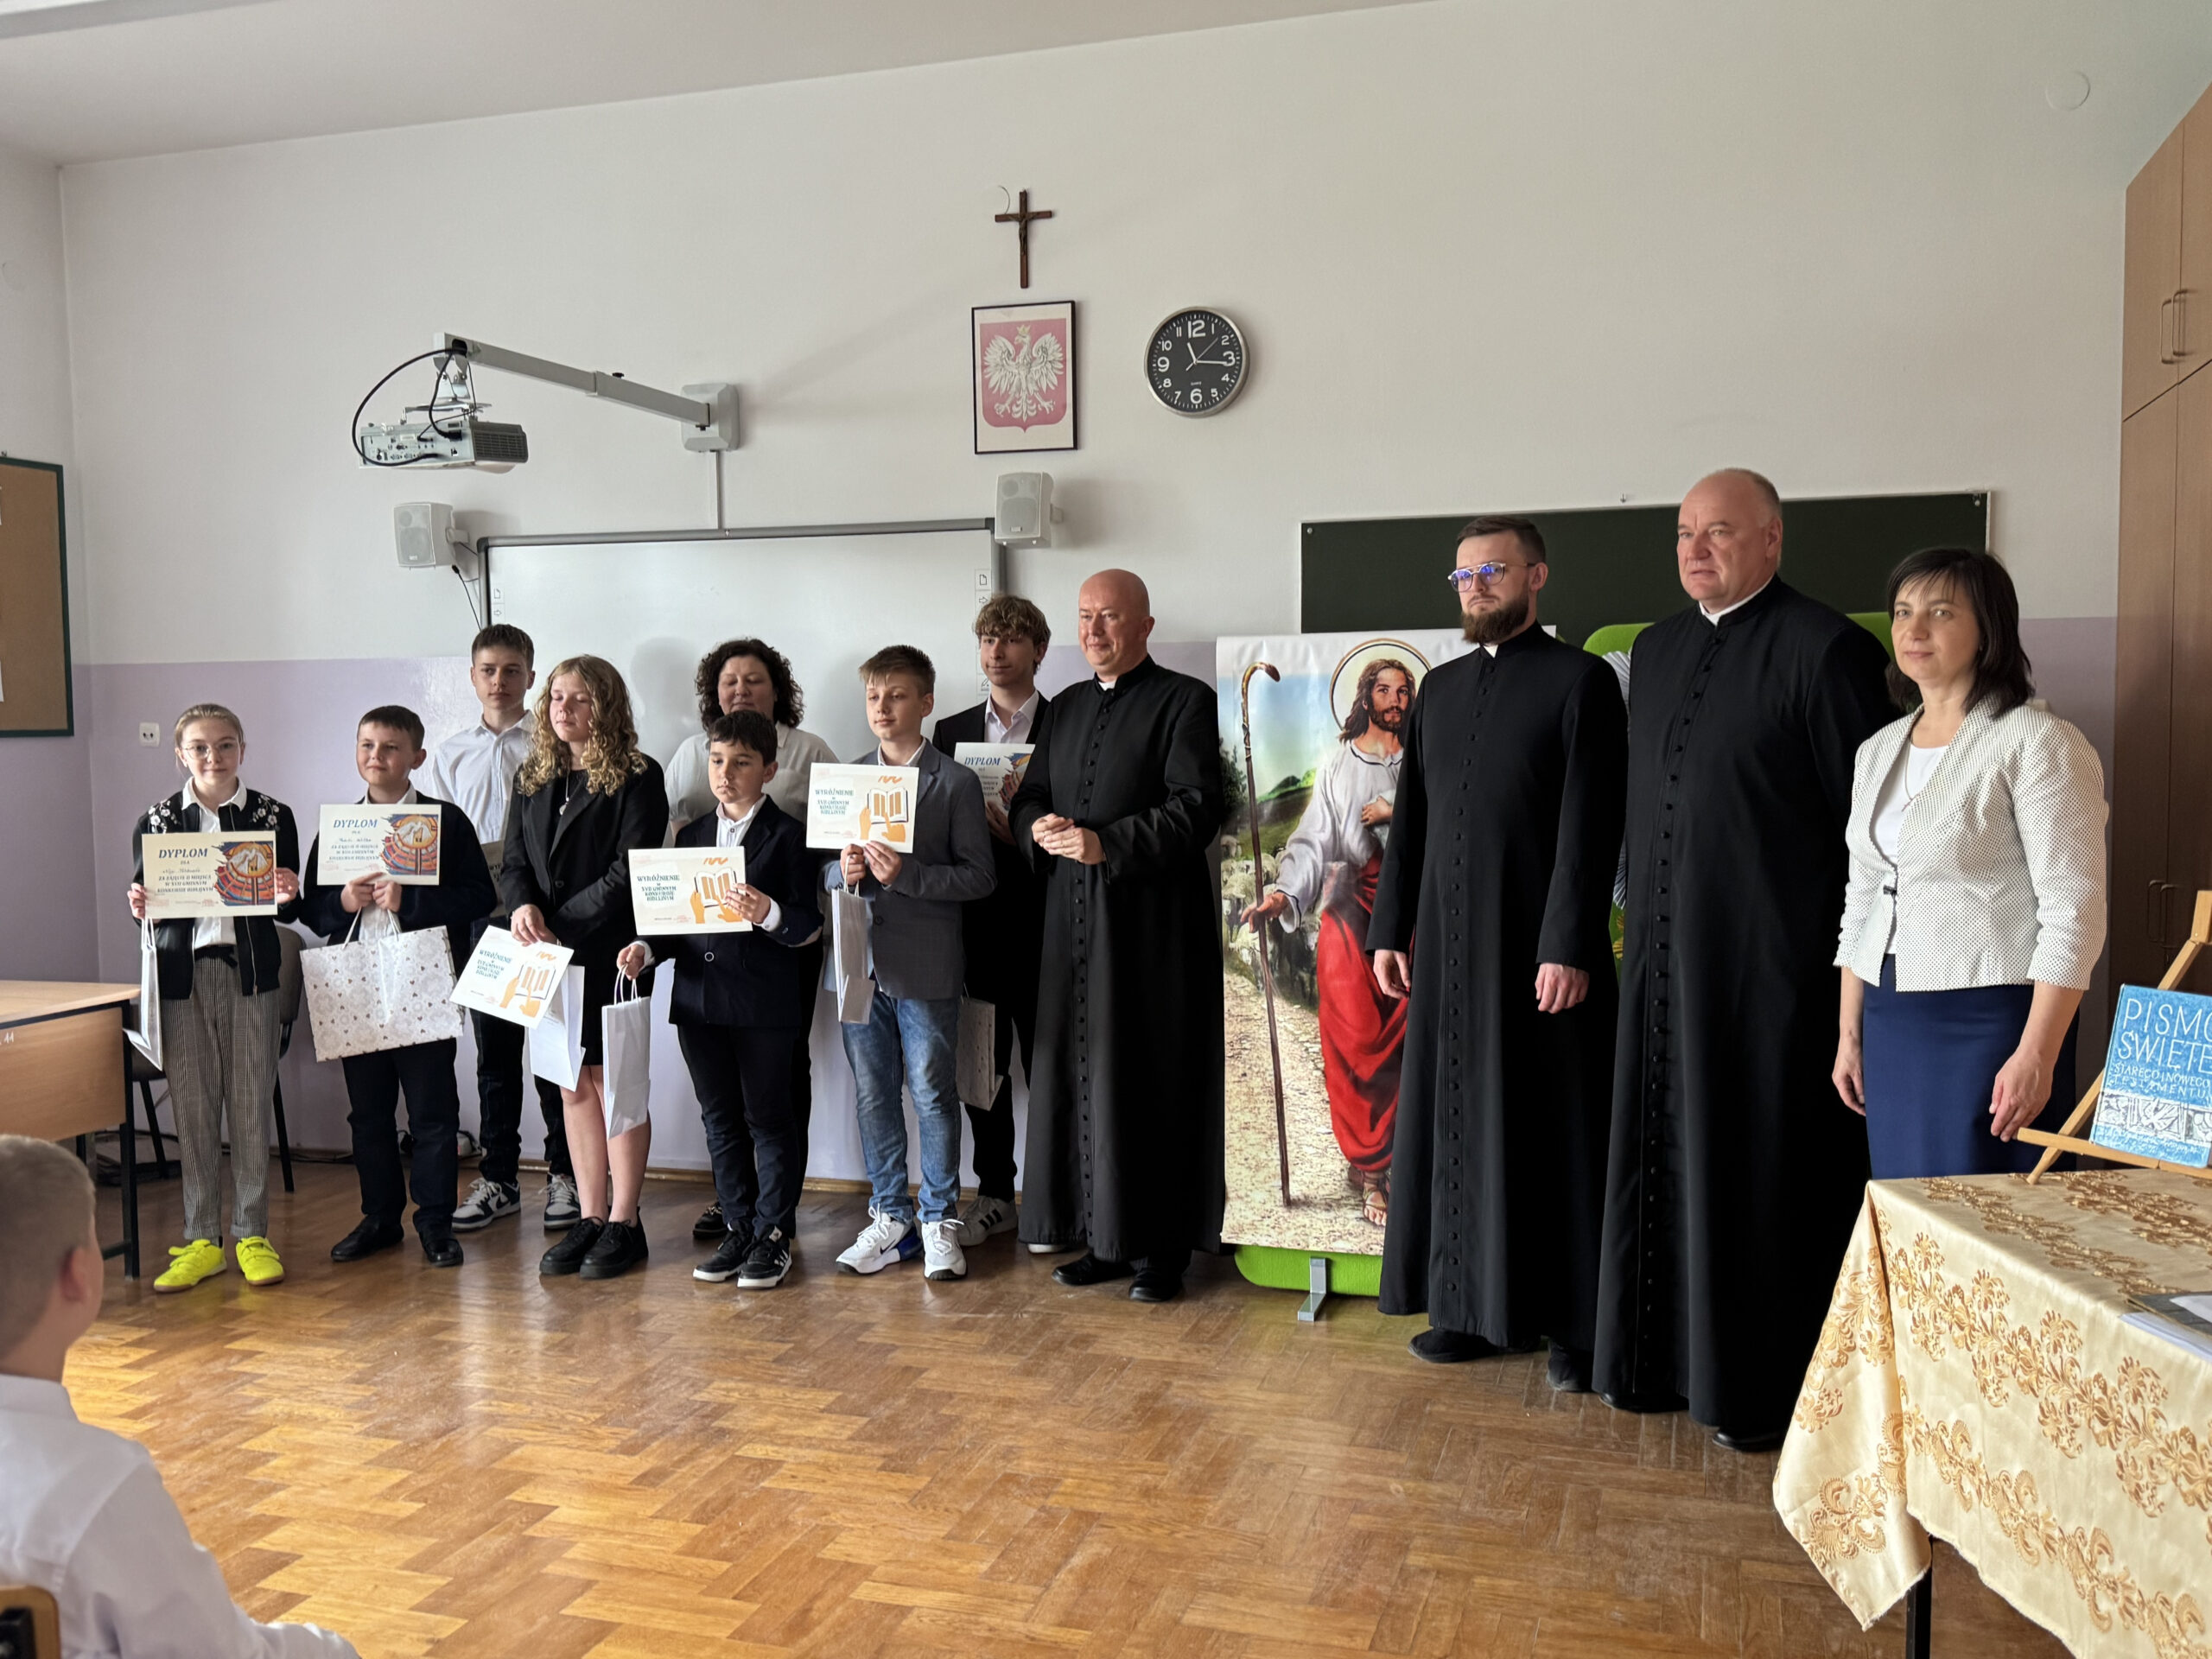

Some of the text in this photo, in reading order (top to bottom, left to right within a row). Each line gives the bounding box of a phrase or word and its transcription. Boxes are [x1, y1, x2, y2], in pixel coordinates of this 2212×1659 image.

[1176, 326, 1182, 338] 11
[1187, 319, 1206, 339] 12
[1211, 322, 1215, 335] 1
[1161, 340, 1173, 352] 10
[1221, 334, 1230, 346] 2
[1157, 356, 1170, 372] 9
[1223, 351, 1236, 366] 3
[1163, 378, 1172, 388] 8
[1221, 373, 1230, 382] 4
[1174, 391, 1182, 402] 7
[1190, 388, 1203, 404] 6
[1211, 388, 1218, 397] 5
[964, 757, 1001, 766] DYPLOM
[333, 818, 378, 829] DYPLOM
[158, 848, 208, 859] DYPLOM
[2165, 1072, 2209, 1088] NOWEGO
